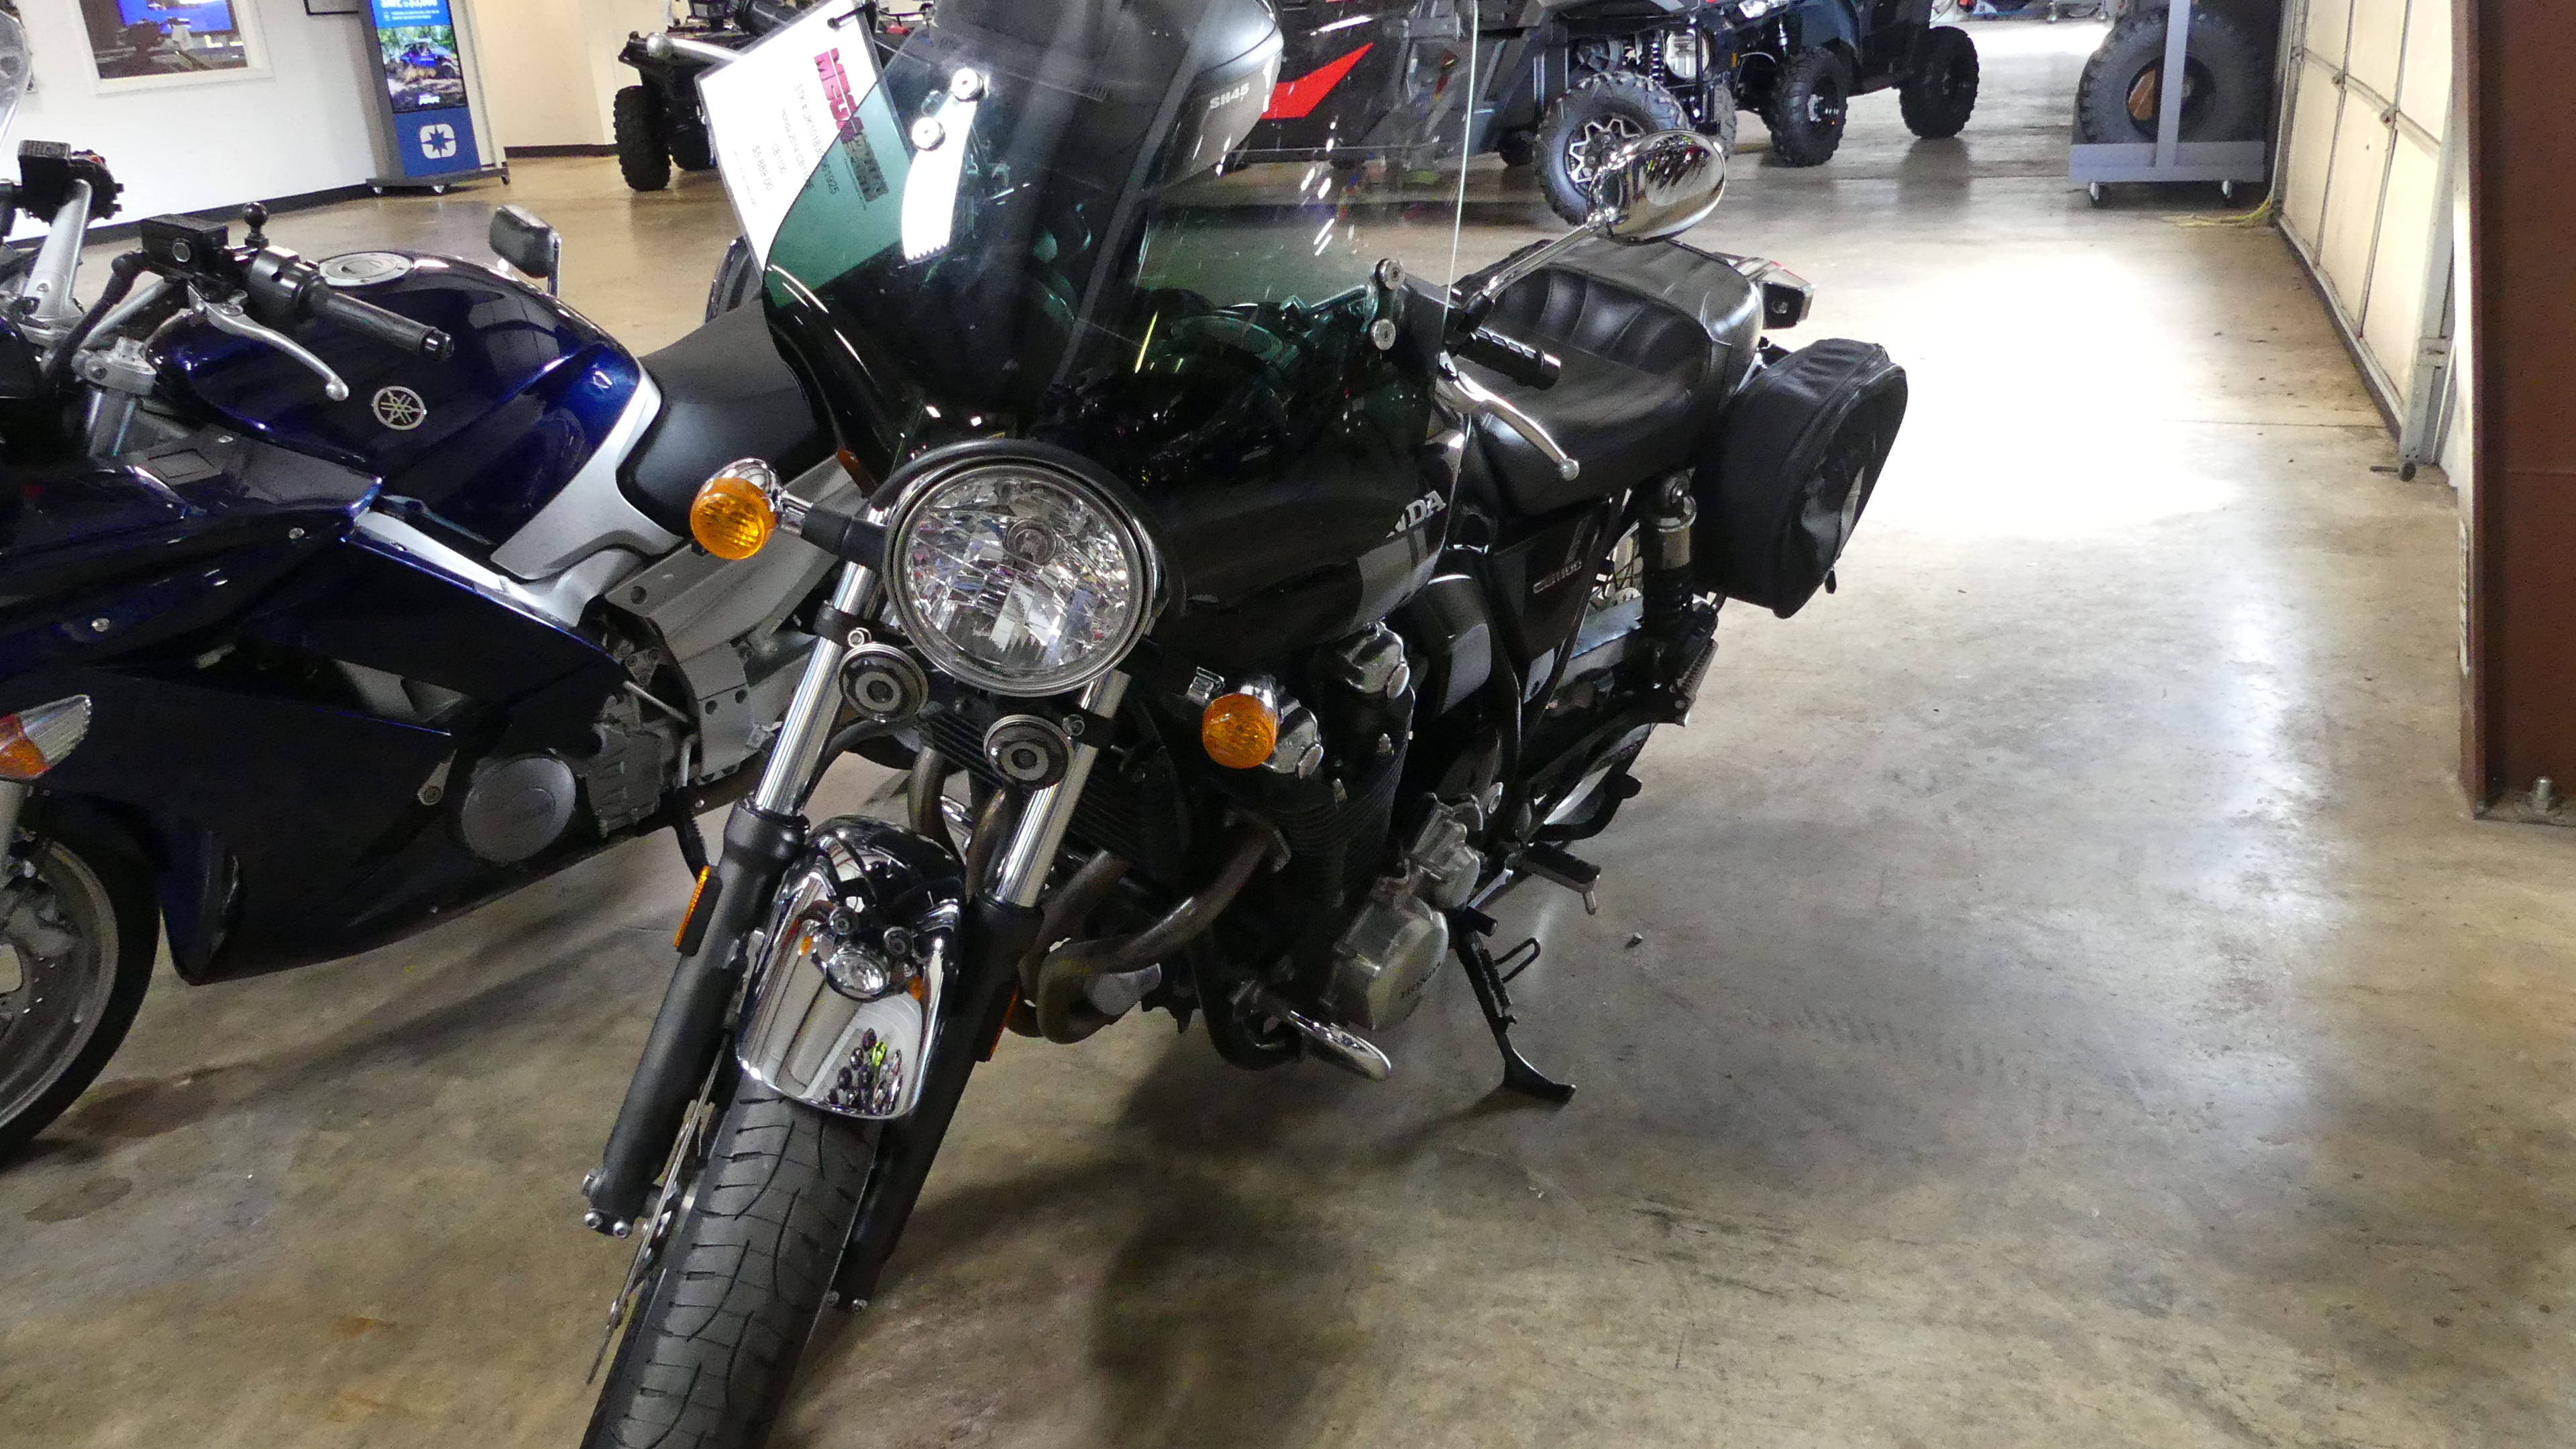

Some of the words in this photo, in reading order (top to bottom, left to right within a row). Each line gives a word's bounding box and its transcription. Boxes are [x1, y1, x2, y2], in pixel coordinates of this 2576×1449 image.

[794, 83, 806, 102] STK
[814, 48, 864, 144] MEGA
[1210, 83, 1249, 110] SH45
[752, 146, 773, 191] $588900
[771, 143, 787, 174] CB1100
[788, 134, 800, 153] 2014
[796, 154, 814, 191] CB110E
